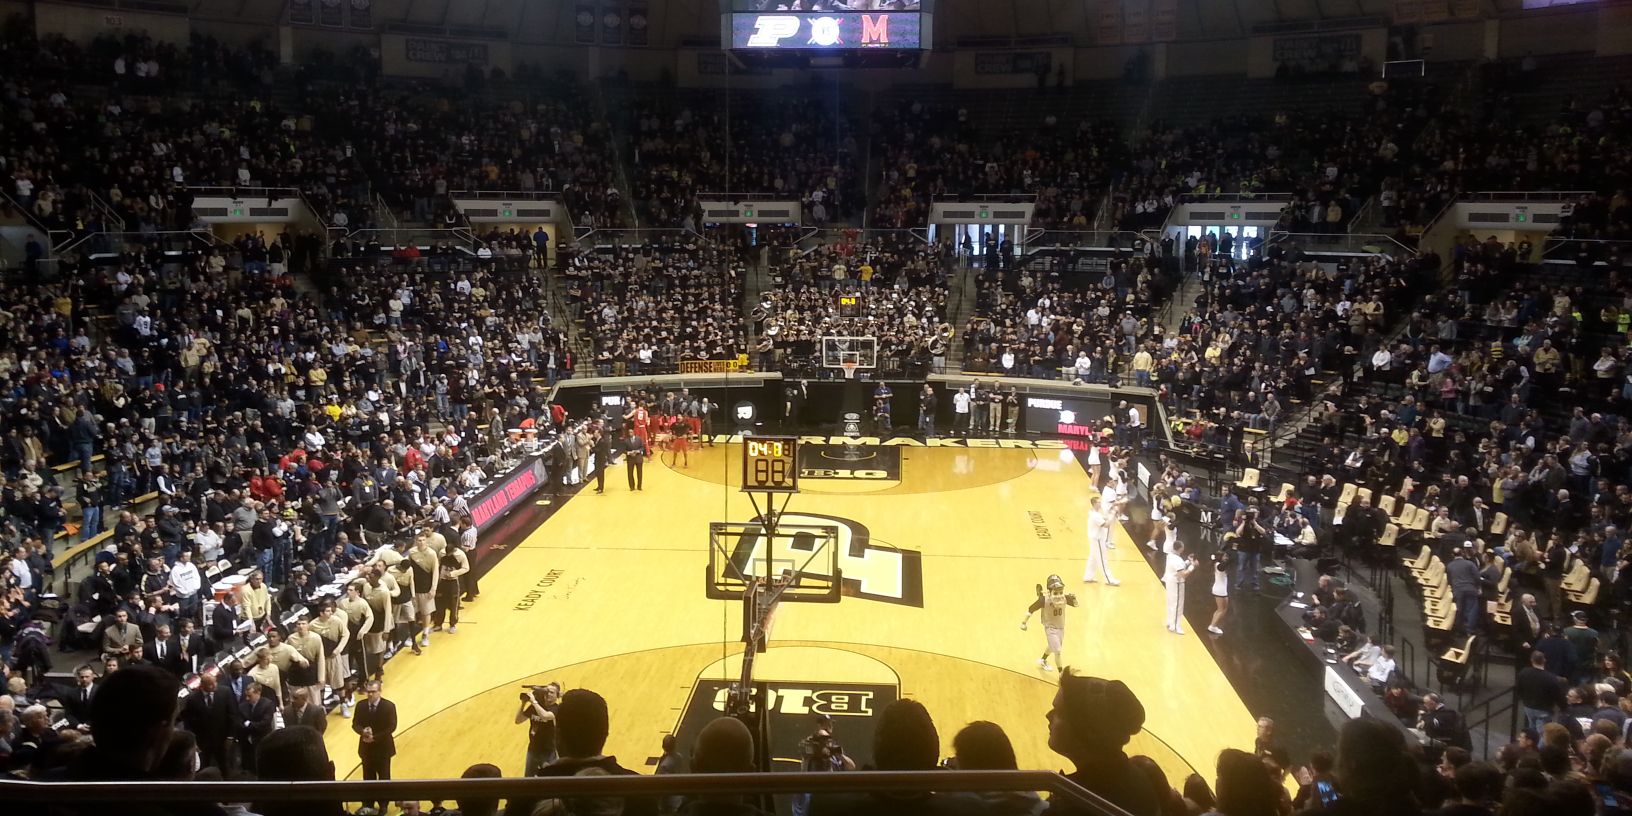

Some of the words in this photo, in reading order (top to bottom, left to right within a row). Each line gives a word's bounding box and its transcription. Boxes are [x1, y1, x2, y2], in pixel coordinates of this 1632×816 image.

[861, 14, 889, 43] M
[680, 361, 713, 374] DEFENSE
[1027, 397, 1063, 410] PURDUE
[470, 489, 509, 528] MARYLAND
[513, 589, 547, 612] KEADY
[536, 568, 566, 589] COURT
